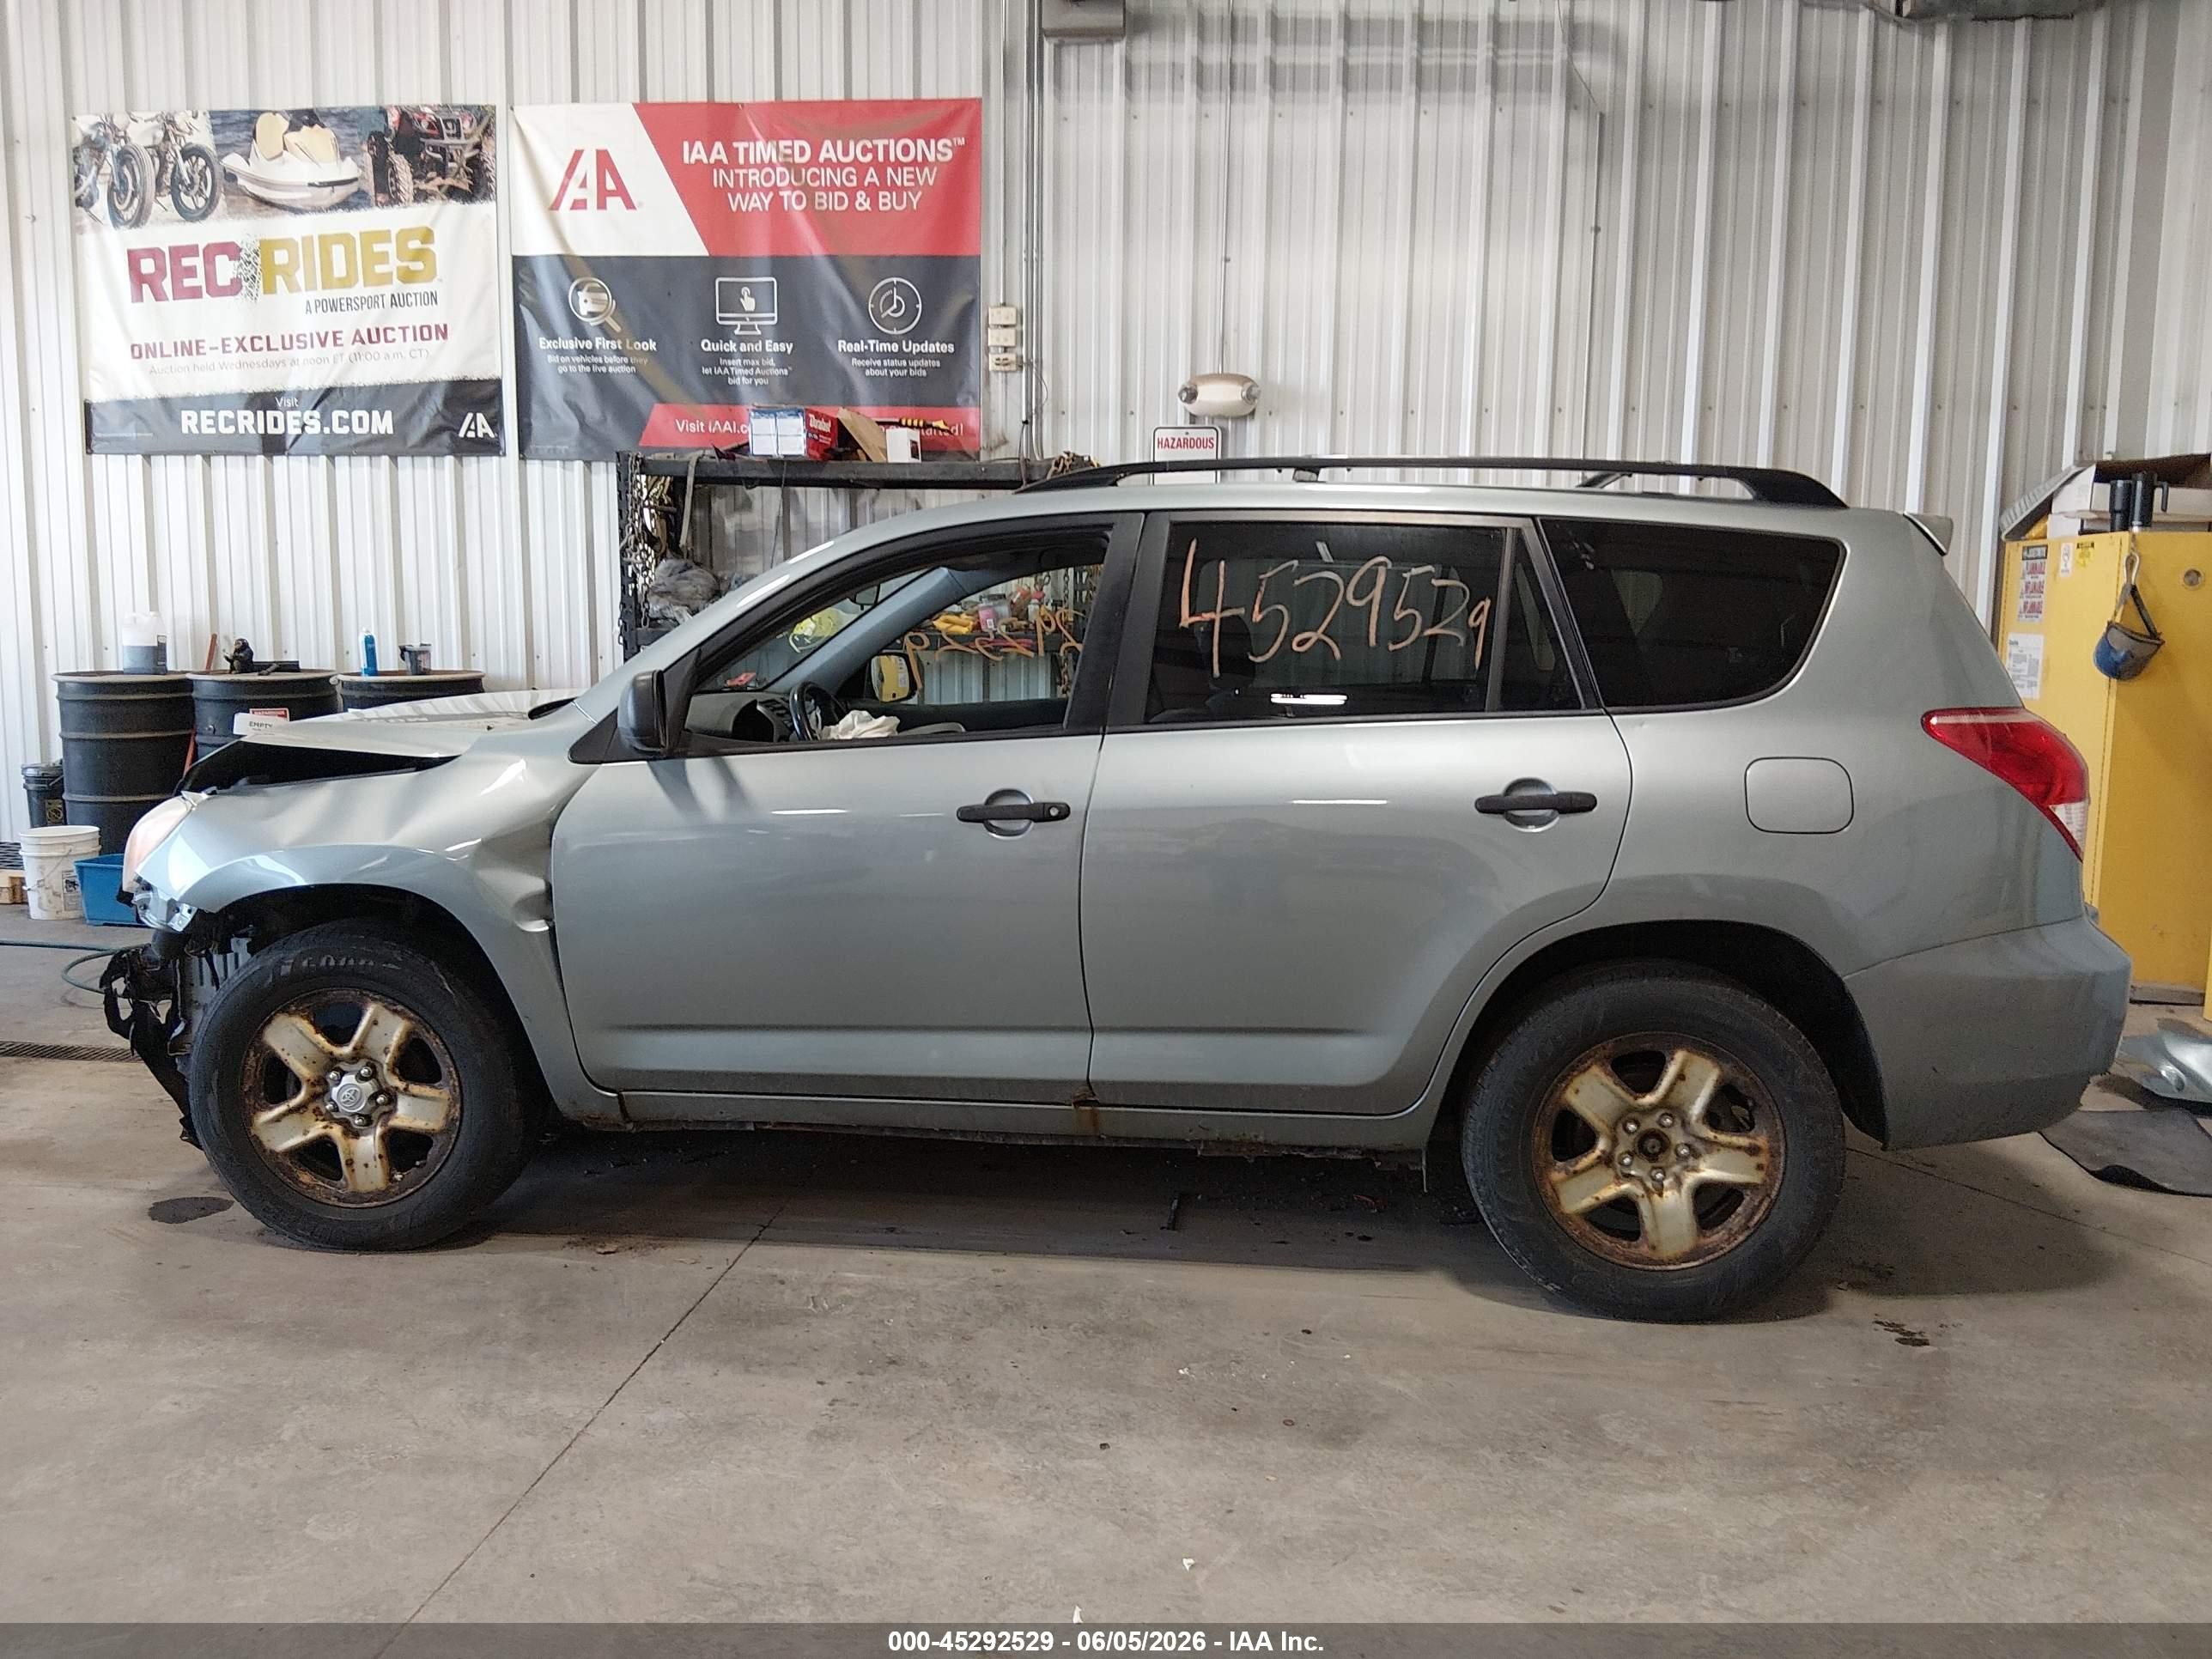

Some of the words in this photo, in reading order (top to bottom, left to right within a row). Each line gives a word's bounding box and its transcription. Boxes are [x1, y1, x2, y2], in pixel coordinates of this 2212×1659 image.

[683, 141, 728, 165] IAA
[732, 140, 811, 164] TIMED
[713, 167, 858, 188] INTRODUCING
[864, 167, 880, 186] A
[886, 166, 938, 186] NEW
[727, 191, 774, 212] WAY
[779, 191, 807, 211] TO
[815, 191, 849, 210] BID
[857, 191, 872, 210] &
[878, 191, 922, 210] BUY
[127, 241, 243, 303] REC
[260, 226, 438, 295] RIDES
[306, 300, 313, 315] A
[314, 295, 386, 314] POWERSPORT
[390, 291, 439, 309] AUCTION
[130, 330, 344, 360] ONLINE-EXCLUSIVE
[350, 323, 449, 345] AUCTION
[538, 337, 593, 349] Exclusive
[595, 337, 623, 349] First
[626, 338, 658, 351] Look
[701, 339, 738, 352] Quick
[739, 340, 763, 352] and
[765, 339, 794, 355] Easy
[837, 339, 899, 353] Real-Time
[902, 340, 956, 355] Updates
[192, 362, 216, 374] held
[217, 357, 288, 372] Wednesdays
[302, 356, 331, 367] noon
[571, 355, 603, 364] vehicles
[604, 356, 629, 365] before
[720, 357, 742, 367] Insert
[851, 358, 882, 368] Receive
[883, 359, 908, 368] status
[908, 359, 941, 370] updates
[578, 364, 592, 373] the
[592, 364, 607, 374] live
[608, 364, 636, 374] auction
[702, 367, 713, 375] let
[714, 367, 730, 375] IAA
[730, 367, 754, 375] Timed
[865, 368, 888, 377] about
[889, 369, 908, 378] your
[909, 368, 927, 377] bids
[727, 376, 741, 386] bid
[742, 376, 753, 385] for
[754, 378, 769, 386] you
[275, 396, 299, 408] Visit
[180, 410, 394, 434] RECRIDES.COM
[675, 418, 706, 433] Visit
[1157, 437, 1215, 450] HAZARDOUS
[1178, 537, 1491, 678] 4529529
